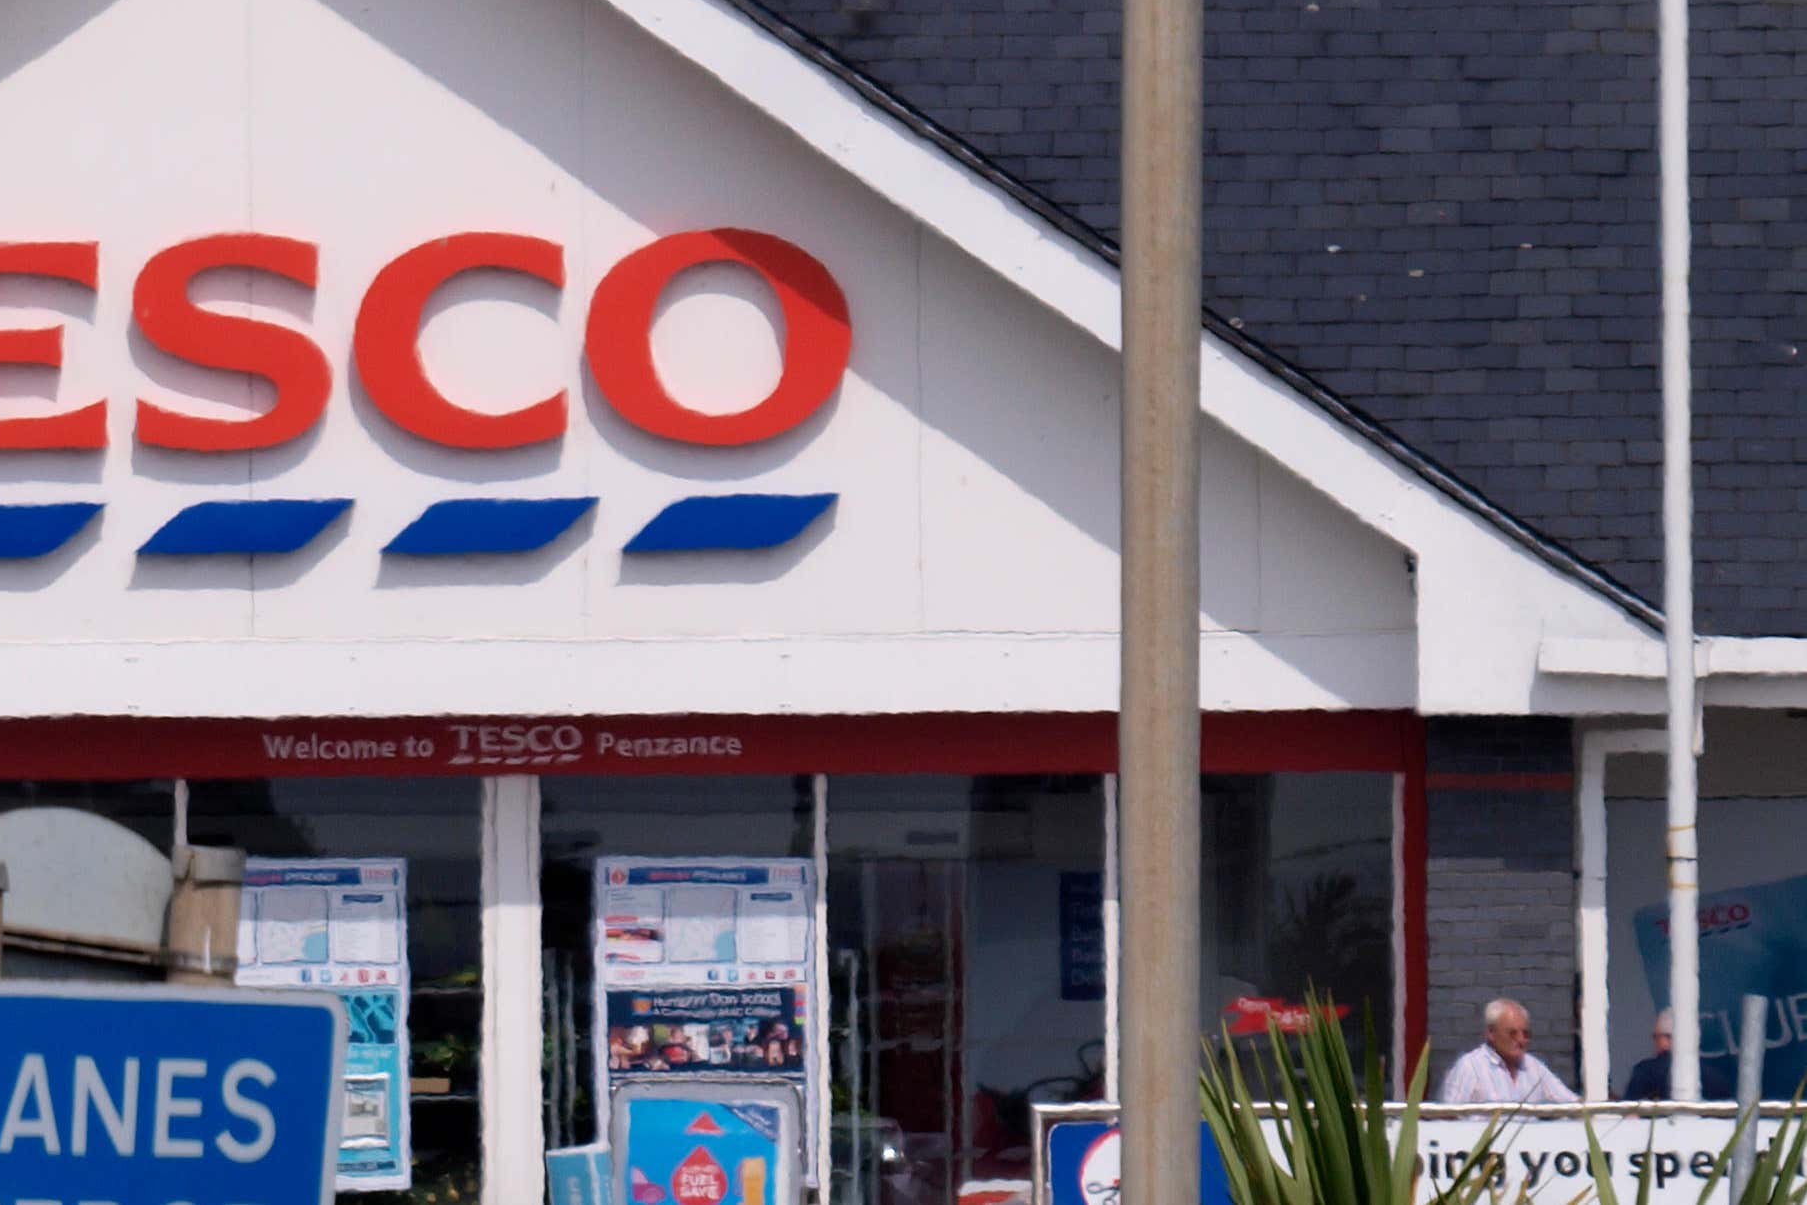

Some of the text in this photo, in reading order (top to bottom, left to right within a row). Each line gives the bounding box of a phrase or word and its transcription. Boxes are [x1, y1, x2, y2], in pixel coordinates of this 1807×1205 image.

[262, 725, 742, 760] Welcome to TESCO Penzance
[1520, 1150, 1613, 1188] you
